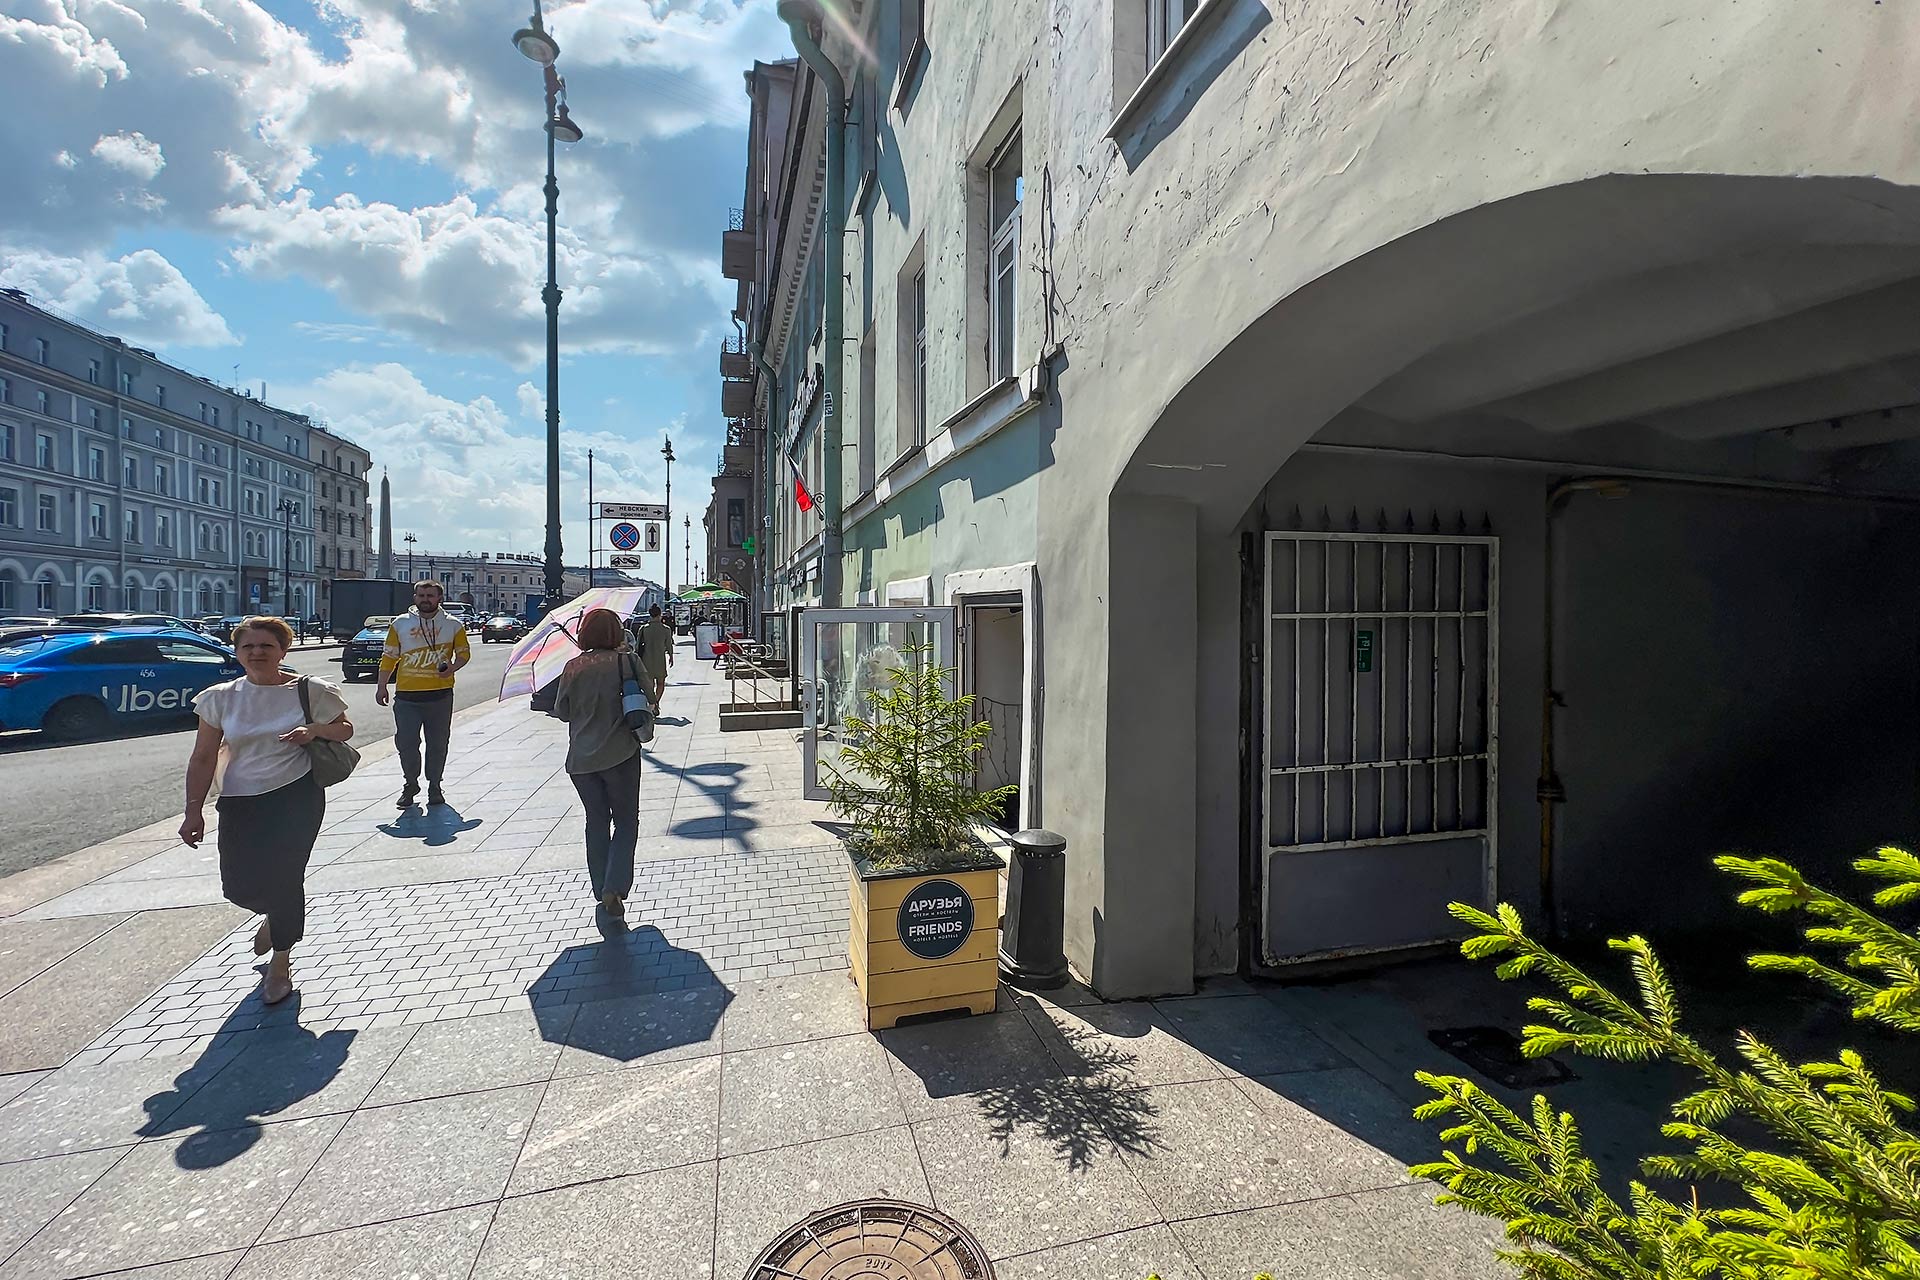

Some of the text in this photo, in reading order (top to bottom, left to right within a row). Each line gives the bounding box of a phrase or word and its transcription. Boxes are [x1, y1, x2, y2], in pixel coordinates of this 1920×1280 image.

[140, 669, 156, 677] 456
[102, 684, 193, 712] Uber
[908, 896, 962, 912] ДРУЗЬЯ
[908, 920, 963, 937] FRIENDS
[865, 1258, 892, 1271] 2017
